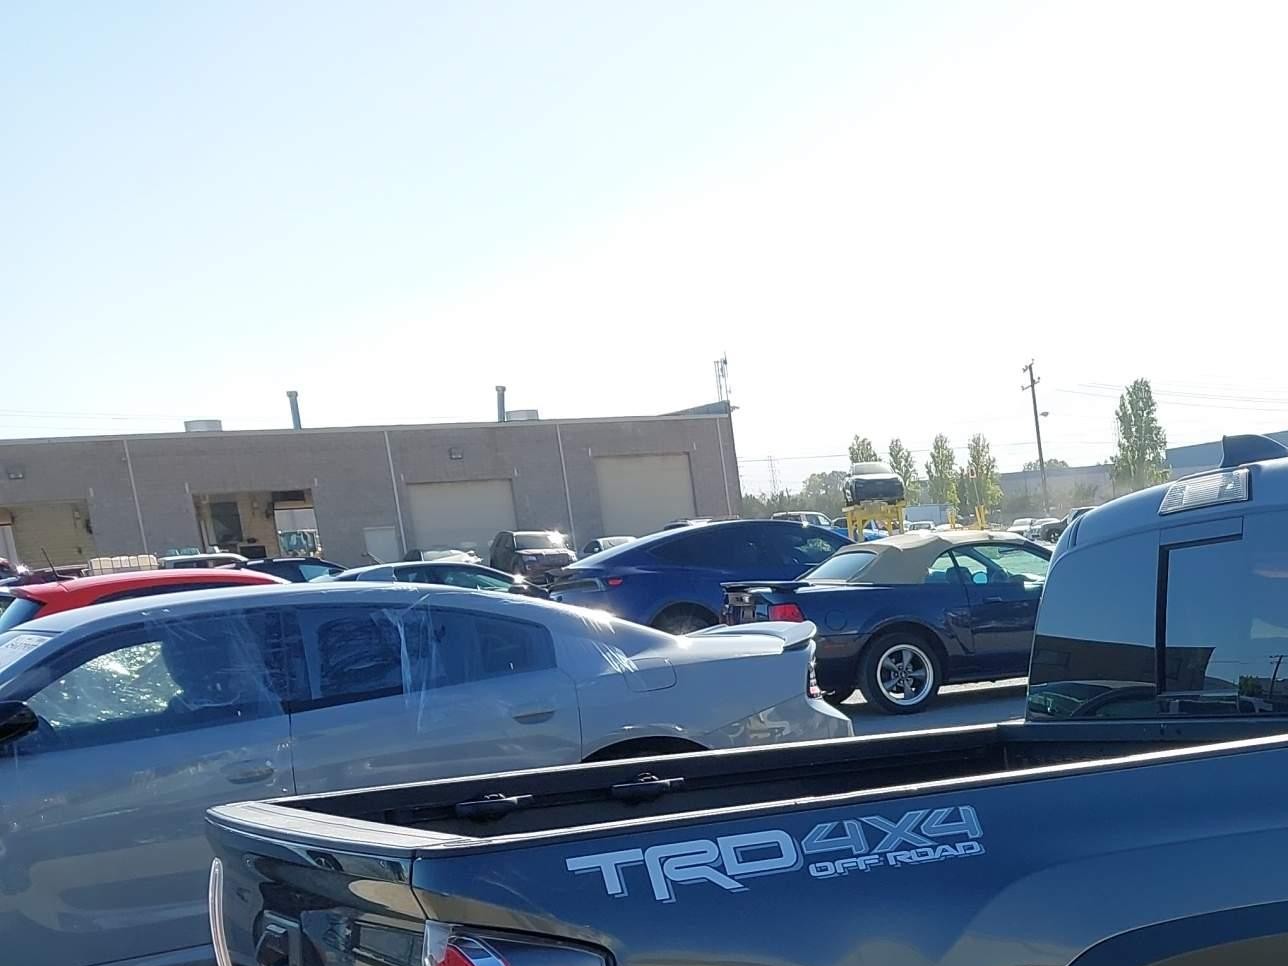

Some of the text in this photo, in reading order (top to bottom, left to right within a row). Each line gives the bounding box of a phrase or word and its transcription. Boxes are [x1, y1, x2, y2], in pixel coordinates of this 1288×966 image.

[566, 829, 803, 903] TRD
[808, 841, 986, 879] OFF ROAD
